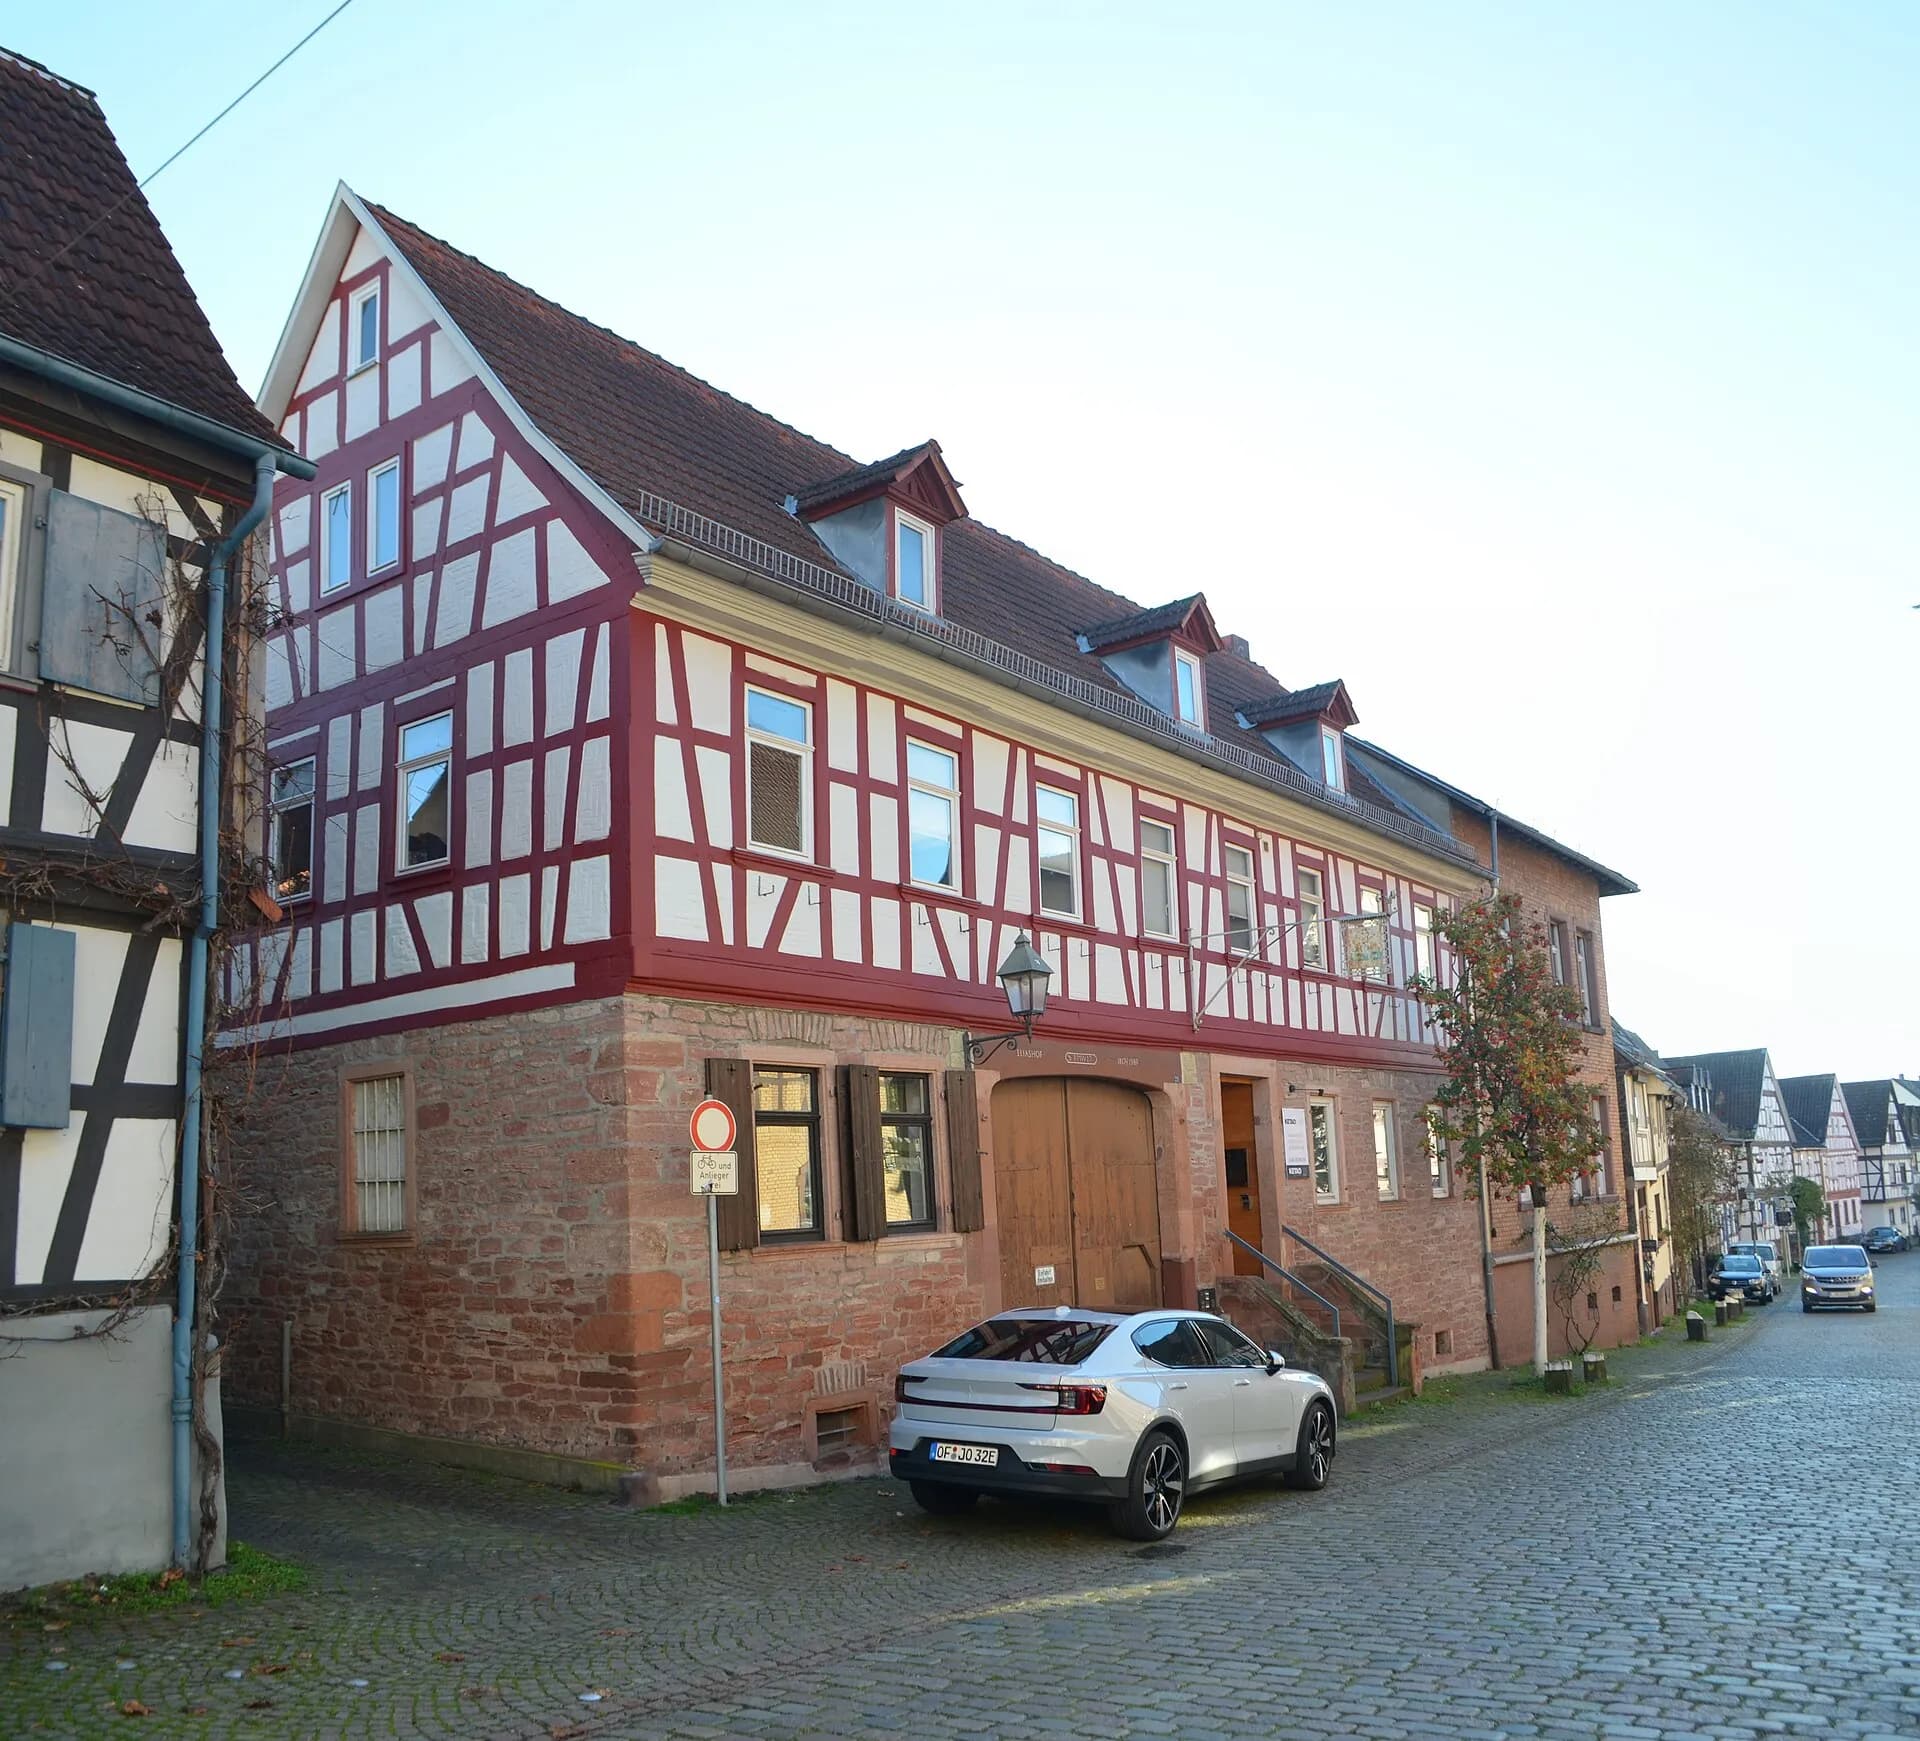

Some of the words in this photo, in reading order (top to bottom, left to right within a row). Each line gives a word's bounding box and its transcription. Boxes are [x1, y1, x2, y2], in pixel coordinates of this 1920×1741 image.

[719, 1162, 732, 1170] und
[699, 1171, 729, 1180] Anlieger
[937, 1446, 952, 1459] OF
[958, 1448, 973, 1461] JO
[974, 1449, 997, 1464] 32E
